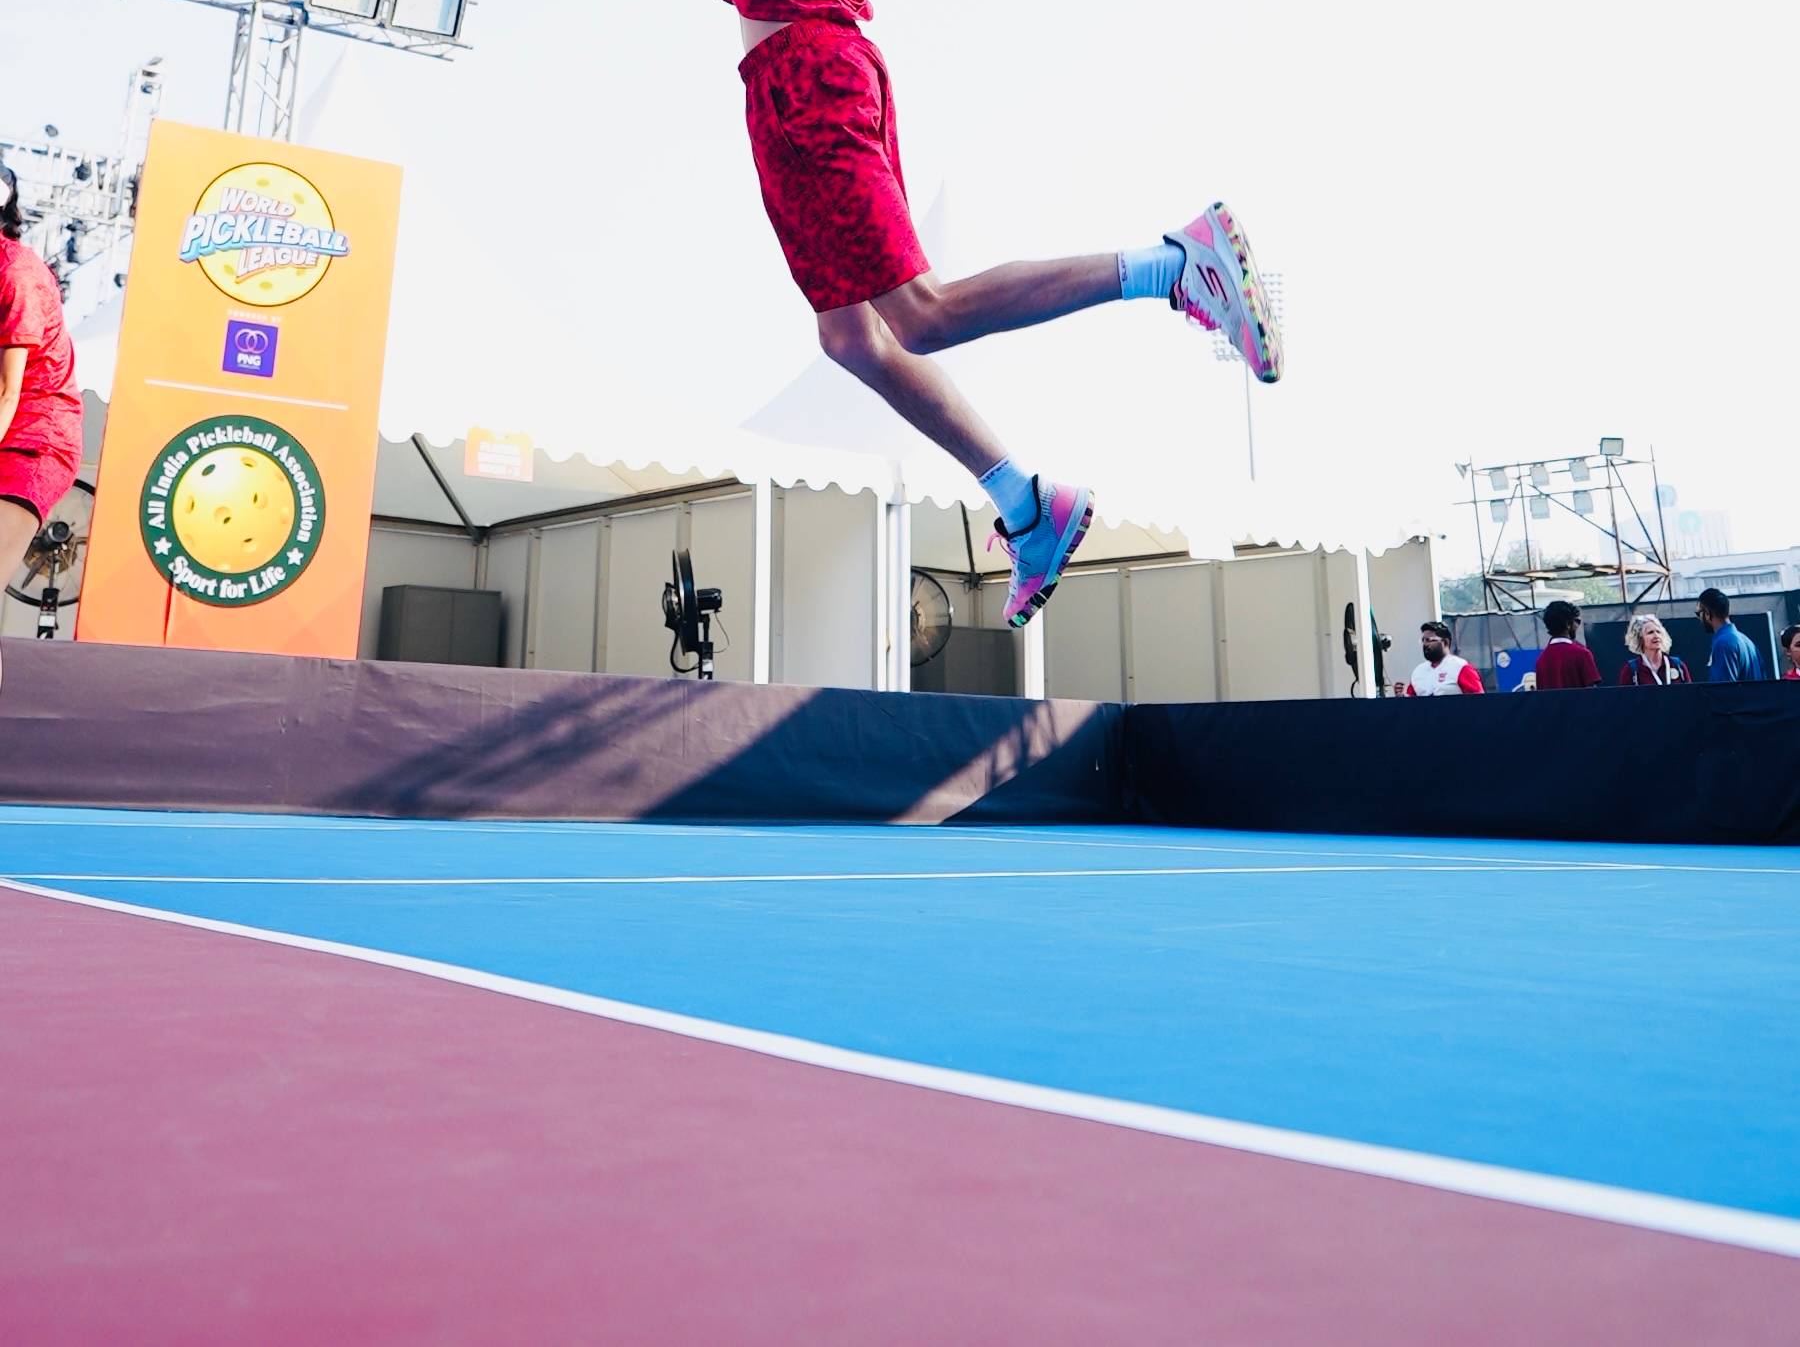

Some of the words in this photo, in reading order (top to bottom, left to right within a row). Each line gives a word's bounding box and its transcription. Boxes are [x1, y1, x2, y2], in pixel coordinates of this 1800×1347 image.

[220, 187, 296, 216] WORLD
[180, 214, 348, 254] PICKLEBALL
[236, 247, 319, 278] LEAGUE
[237, 352, 261, 366] PNG
[186, 425, 277, 454] Pickleball
[151, 449, 190, 497] India
[273, 446, 318, 543] Association
[147, 500, 166, 530] All
[168, 555, 217, 596] Sport
[219, 578, 248, 599] for
[248, 566, 287, 595] Life
